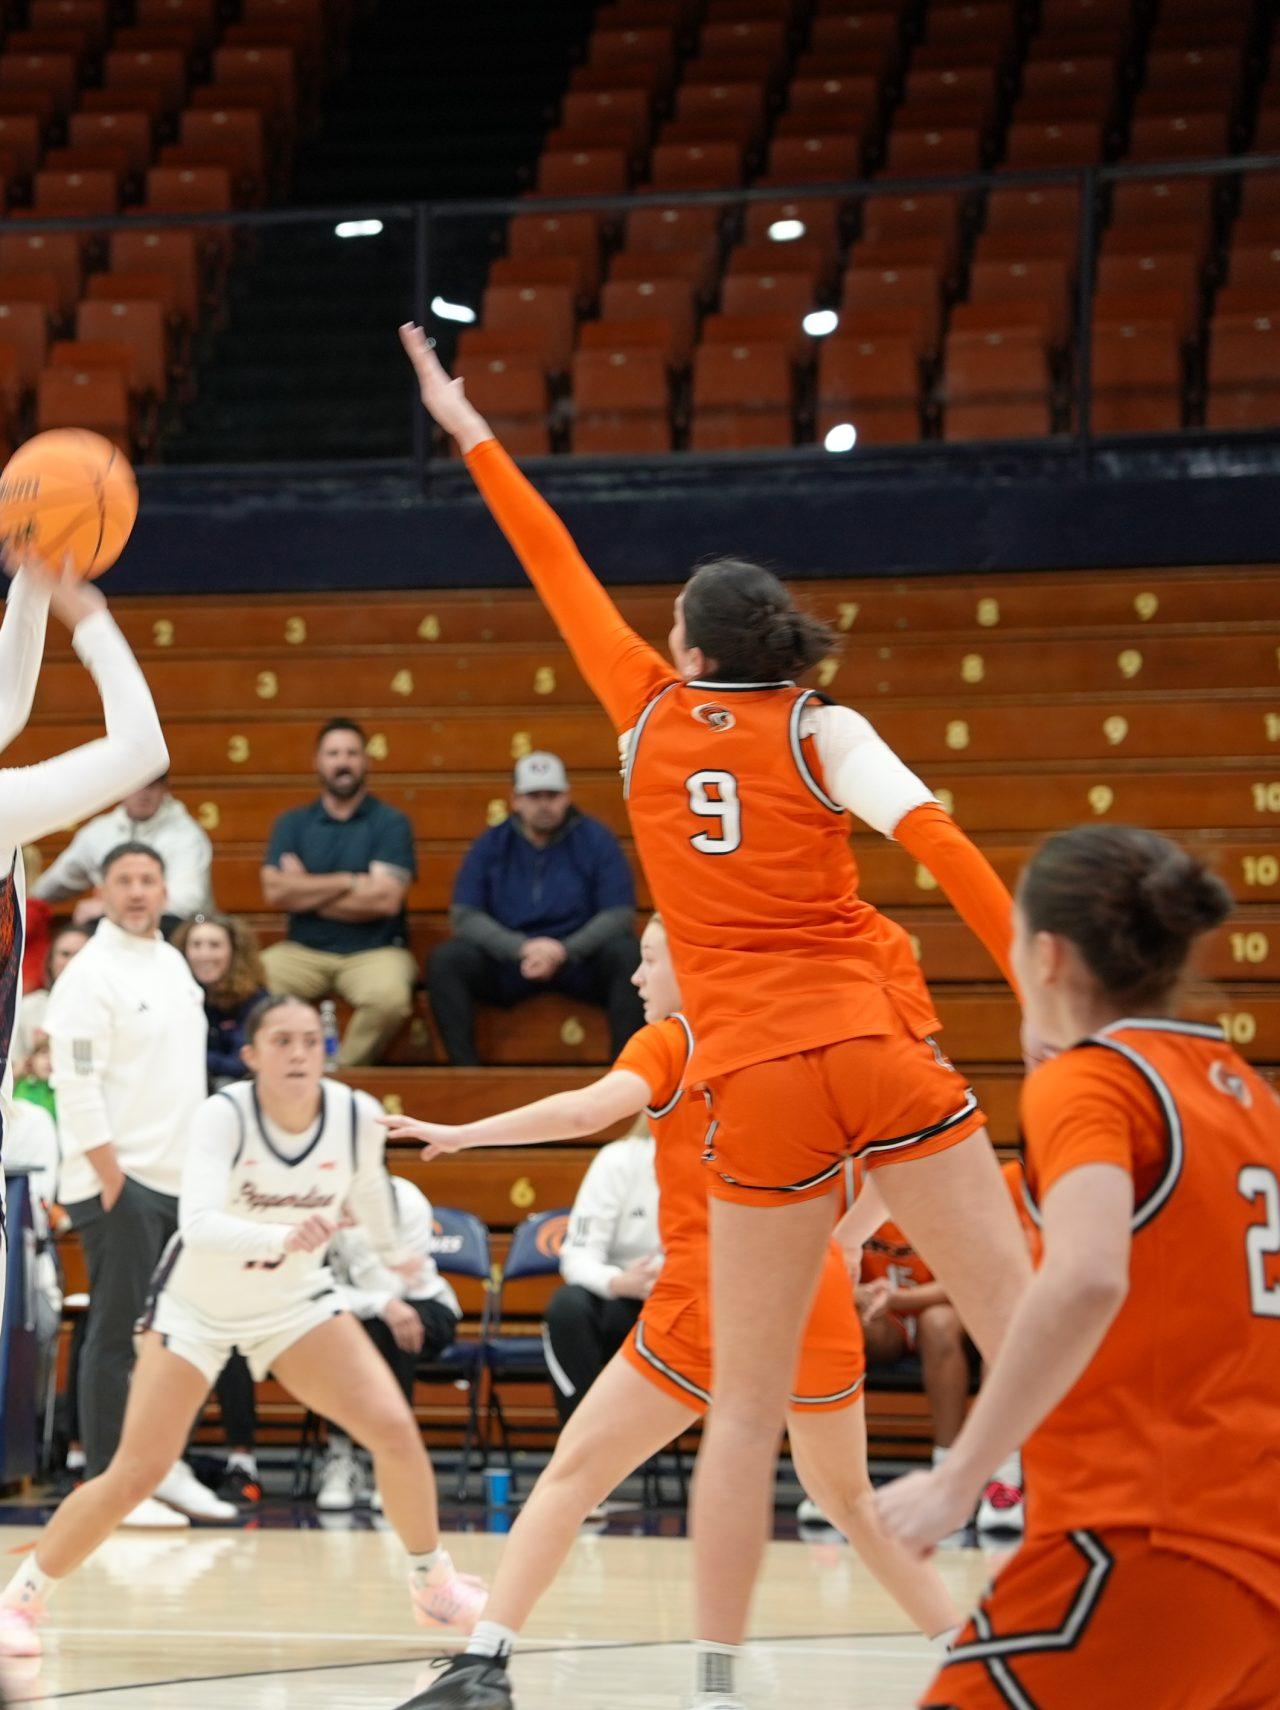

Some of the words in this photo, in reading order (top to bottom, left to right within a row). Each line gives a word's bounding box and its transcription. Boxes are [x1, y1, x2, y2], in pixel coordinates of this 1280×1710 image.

[837, 602, 858, 631] 7
[976, 598, 999, 627] 8
[1136, 592, 1159, 621] 9
[154, 619, 174, 648] 2
[285, 616, 306, 644] 3
[418, 615, 439, 641] 4
[961, 653, 984, 683] 8
[1118, 649, 1143, 678] 9
[256, 670, 278, 699] 3
[391, 669, 413, 697] 4
[534, 666, 556, 695] 5
[945, 719, 969, 750] 8
[1102, 715, 1128, 745] 9
[228, 734, 250, 764] 3
[684, 767, 743, 856] 9
[1087, 784, 1113, 814] 9
[1251, 782, 1280, 813] 10
[1242, 855, 1279, 886] 10
[1230, 932, 1269, 963] 10
[561, 1015, 587, 1045] 6
[1218, 1012, 1257, 1044] 10
[510, 1176, 536, 1208] 6
